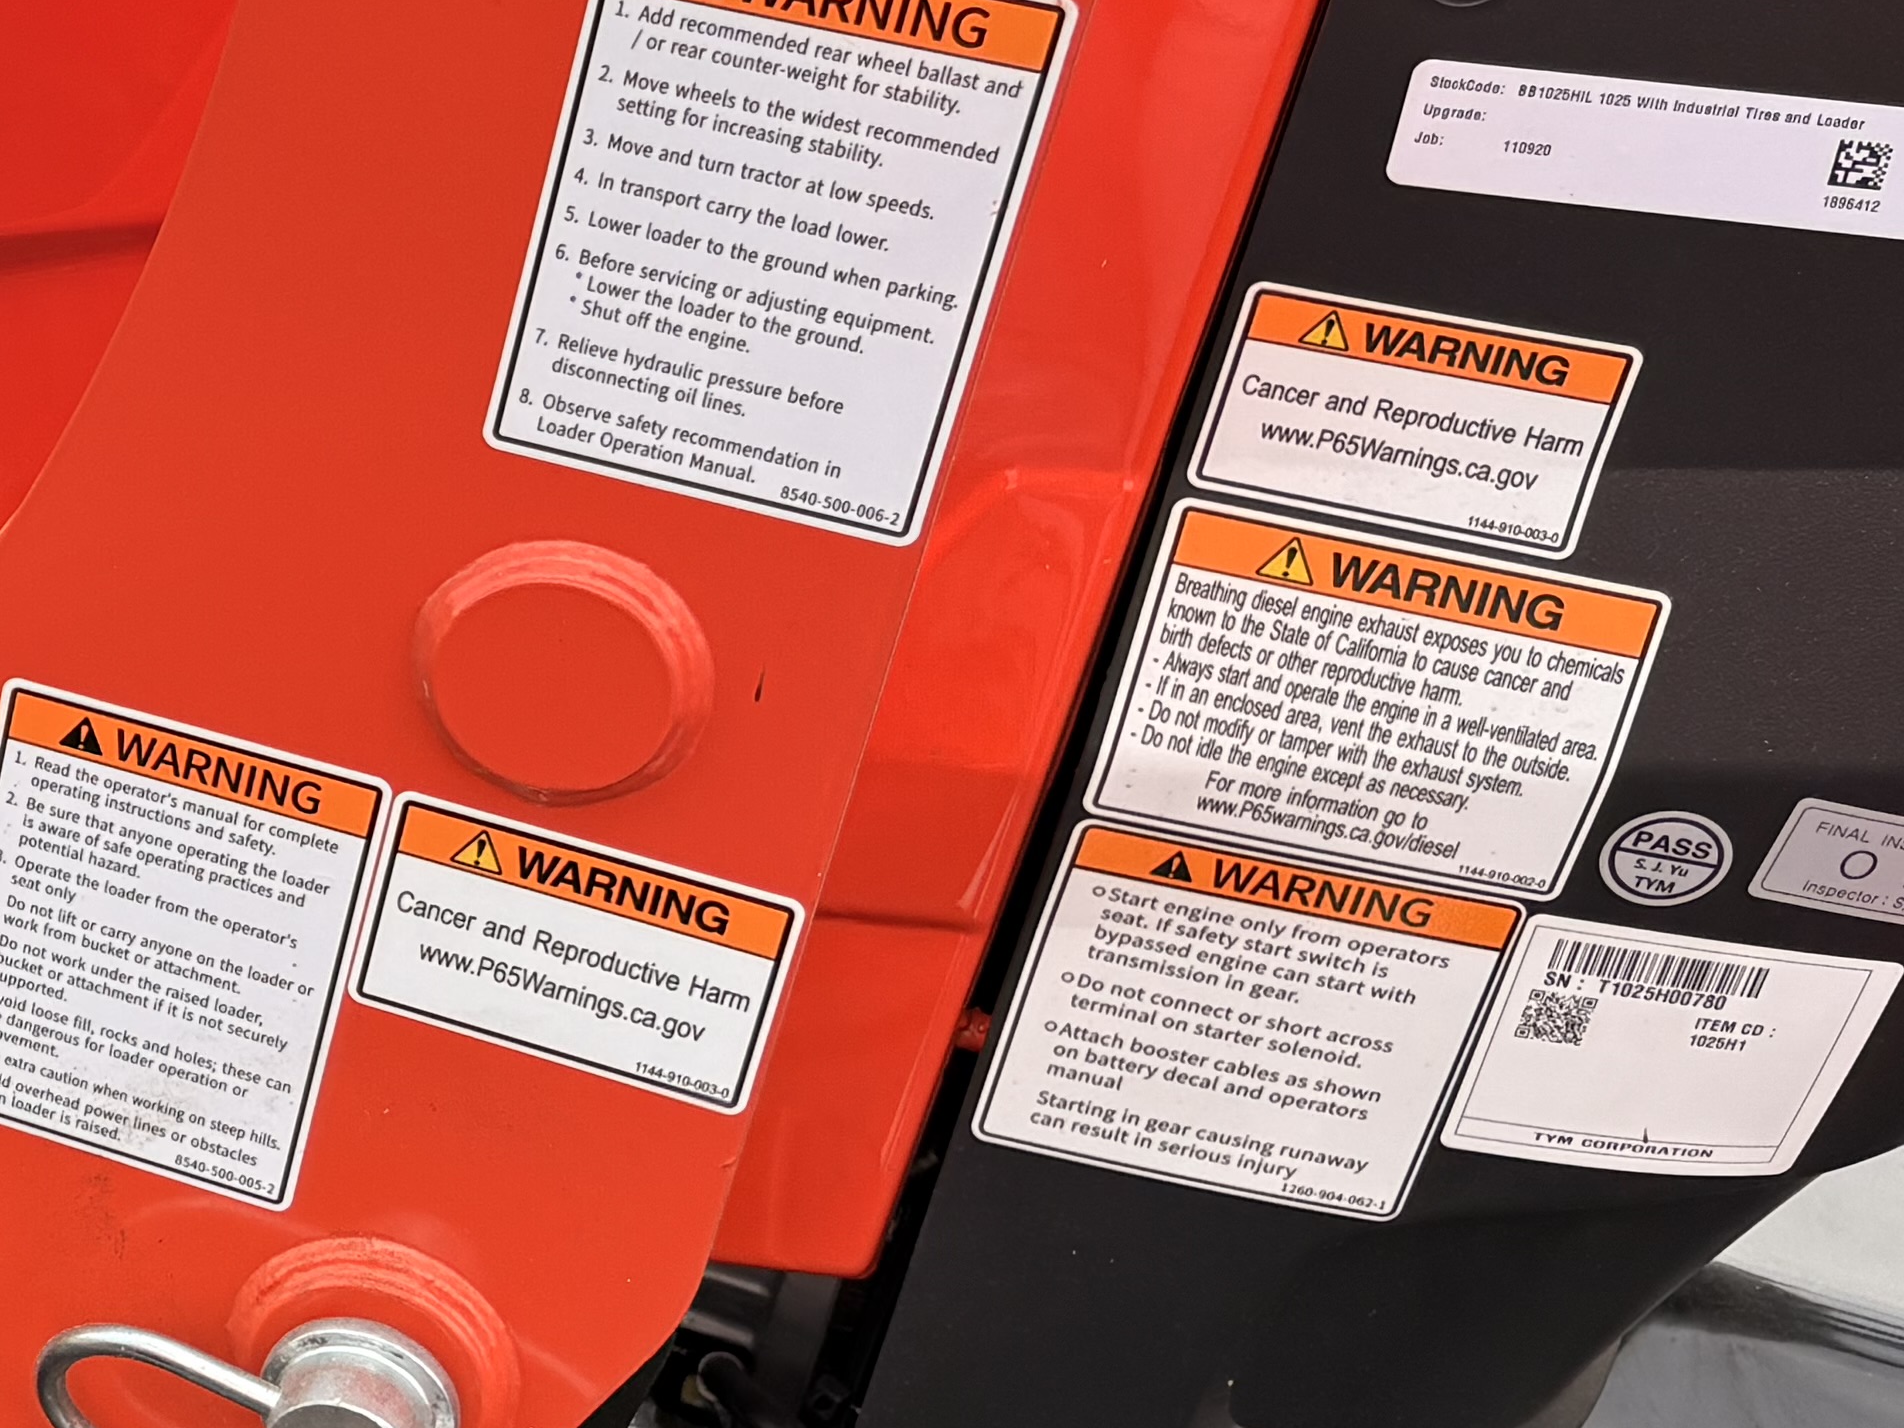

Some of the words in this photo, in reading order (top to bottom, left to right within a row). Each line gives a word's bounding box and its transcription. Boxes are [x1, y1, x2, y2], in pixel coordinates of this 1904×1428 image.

[637, 5, 675, 27] Add
[679, 17, 810, 55] recommended
[814, 44, 852, 63] rear
[857, 51, 912, 76] wheel
[916, 59, 980, 90] ballast
[983, 79, 1024, 98] and
[645, 36, 666, 51] or
[670, 41, 707, 60] rear
[711, 50, 848, 90] counter-weight
[852, 73, 880, 95] for
[882, 84, 960, 116] stability.
[616, 97, 677, 126] setting
[681, 106, 708, 128] for
[712, 113, 804, 153] increasing
[807, 137, 882, 169] stability.
[622, 69, 669, 94] Move
[675, 81, 736, 108] wheels
[742, 95, 760, 113] to
[766, 99, 795, 121] the
[802, 109, 861, 135] widest
[865, 124, 1000, 164] recommended
[1413, 131, 1444, 145] Job:
[1504, 140, 1551, 156] 110920
[1423, 103, 1486, 121] Upgrade:
[1599, 92, 1631, 106] 1025
[1636, 95, 1668, 110] With
[1745, 106, 1780, 121] Tires
[1784, 112, 1811, 124] and
[1816, 113, 1865, 130] Loader
[607, 133, 653, 158] Move
[657, 148, 693, 166] and
[698, 153, 734, 176] turn
[740, 162, 801, 189] tractor
[805, 179, 824, 196] at
[828, 180, 862, 203] low
[865, 193, 933, 220] speeds.
[1823, 195, 1880, 212] 1896412
[587, 210, 642, 236] Lower
[645, 221, 701, 250] loader
[706, 237, 724, 255] to
[730, 242, 758, 263] the
[761, 253, 828, 278] ground
[833, 267, 881, 291] when
[884, 281, 957, 311] parking.
[1365, 322, 1569, 387] WARNING
[1241, 373, 1320, 407] Cancer
[1324, 394, 1369, 416] and
[1372, 397, 1516, 444] Reproductive
[1522, 425, 1584, 457] Harm
[1261, 422, 1539, 490] www.P65Warnings.ca.gov
[779, 485, 900, 526] 8540-500-006-2
[1468, 515, 1559, 543] 1144-910-003-0
[1332, 551, 1564, 631] WARNING
[1166, 597, 1216, 627] known
[1240, 613, 1265, 637] the
[1269, 618, 1310, 647] State
[1313, 629, 1334, 651] of
[1335, 632, 1407, 667] California
[1431, 658, 1479, 682] cause
[1483, 668, 1539, 693] cancer
[1539, 679, 1574, 701] and
[1174, 571, 1248, 612] Breathing
[1250, 589, 1299, 617] diesel
[1300, 603, 1353, 629] engine
[1356, 613, 1420, 643] exhaust
[1422, 629, 1488, 657] exposes
[1489, 643, 1522, 664] you
[1546, 650, 1625, 684] chemicals
[34, 755, 71, 777] Read
[75, 767, 99, 785] the
[103, 778, 177, 808] operator's
[182, 800, 239, 825] manual
[243, 813, 265, 832] for
[268, 825, 338, 854] complete
[117, 727, 322, 814] WARNING
[30, 776, 100, 808] operating
[104, 793, 190, 830] instructions
[195, 823, 224, 840] and
[227, 832, 275, 856] safety.
[1196, 795, 1461, 859] www.P65warnings.ca.gov/diesel
[1632, 831, 1712, 859] PASS
[1816, 821, 1870, 843] FINAL
[517, 845, 729, 936] WARNING
[1213, 858, 1434, 927] WARNING
[1635, 875, 1675, 893] TYM
[1671, 864, 1689, 877] Yu
[1802, 880, 1879, 905] Inspector
[396, 890, 477, 931] Cancer
[482, 920, 526, 946] and
[532, 929, 680, 991] Reproductive
[687, 974, 750, 1012] Harm
[1100, 908, 1147, 929] seat.
[1155, 917, 1173, 932] If
[1174, 924, 1239, 950] safety
[1242, 938, 1292, 959] start
[1296, 950, 1365, 973] switch
[1107, 887, 1159, 910] Start
[1163, 901, 1234, 926] engine
[1239, 917, 1286, 939] only
[1291, 923, 1341, 947] from
[1347, 939, 1450, 968] operators
[419, 943, 705, 1041] www.P65Warnings.ca.gov
[1543, 970, 1572, 988] SN
[1599, 978, 1727, 1010] T1025H00780
[1694, 1017, 1737, 1033] ITEM
[1740, 1023, 1764, 1036] CD
[39, 1066, 88, 1089] caution
[92, 1082, 127, 1102] when
[132, 1095, 185, 1123] working
[209, 1119, 245, 1140] steep
[249, 1128, 280, 1150] hills.
[636, 1061, 729, 1098] 1144-910-003-0
[174, 1154, 274, 1194] 8540-500-005-2
[1534, 1132, 1573, 1145] TYM
[1581, 1139, 1713, 1158] CORPORATION
